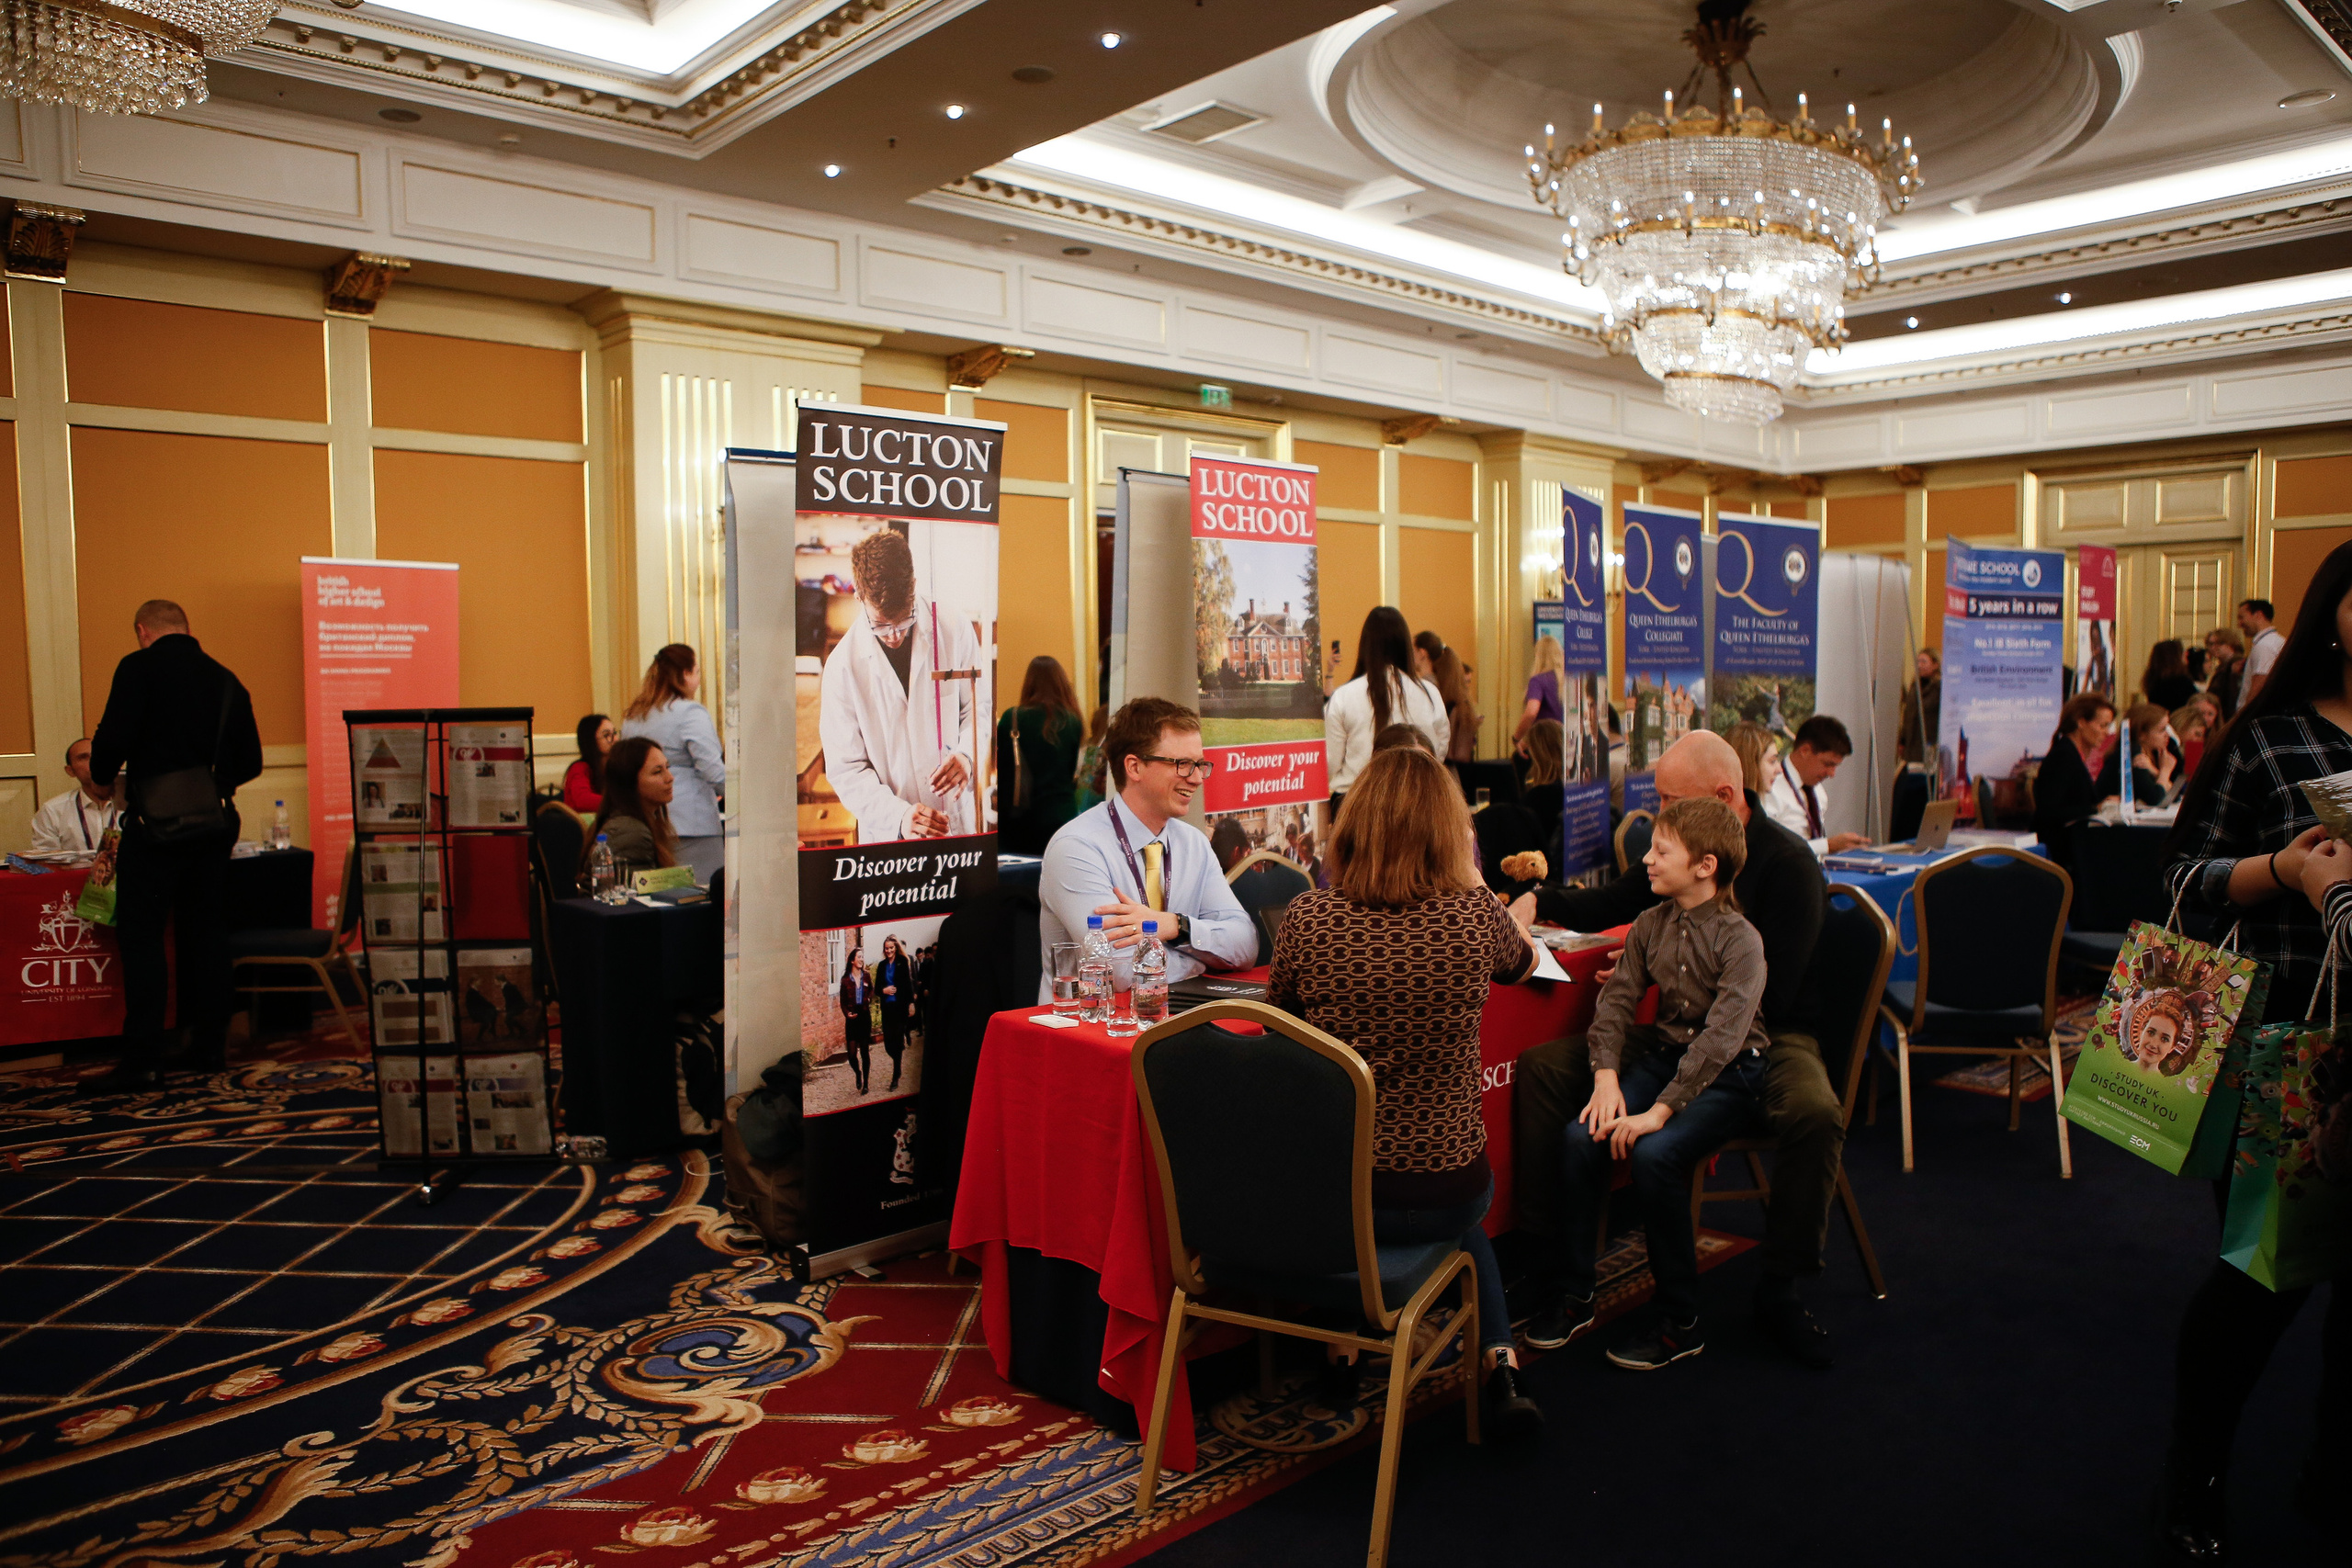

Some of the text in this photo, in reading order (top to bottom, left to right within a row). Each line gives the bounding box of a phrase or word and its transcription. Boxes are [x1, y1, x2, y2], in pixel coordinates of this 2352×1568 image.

[809, 422, 993, 473] LUCTON
[812, 466, 992, 513] SCHOOL
[1198, 468, 1310, 505] LUCTON
[1201, 502, 1313, 537] SCHOOL
[1979, 560, 2020, 577] SCHOOL
[1629, 613, 1653, 628] QUEEN
[1969, 597, 1977, 614] 5
[1978, 599, 2010, 616] years
[2012, 597, 2025, 615] in
[2026, 602, 2035, 615] a
[2036, 602, 2059, 615] row
[1645, 628, 1683, 642] COLLEGIATE
[1733, 615, 1749, 629] THE
[1752, 616, 1786, 630] FACULTY
[1720, 630, 1751, 645] QUEEN
[1226, 750, 1320, 773] Discover your
[1242, 771, 1305, 802] potential
[832, 849, 982, 882] Discover your
[858, 876, 957, 917] potential
[21, 958, 111, 987] CITY
[2090, 1073, 2148, 1109] DISCOVER
[2152, 1102, 2177, 1122] YOU
[2115, 1072, 2160, 1099] STUDY UK
[2098, 1094, 2160, 1130] WWW.STUDYUKRUSSIA.RU
[879, 1191, 921, 1211] Founded
